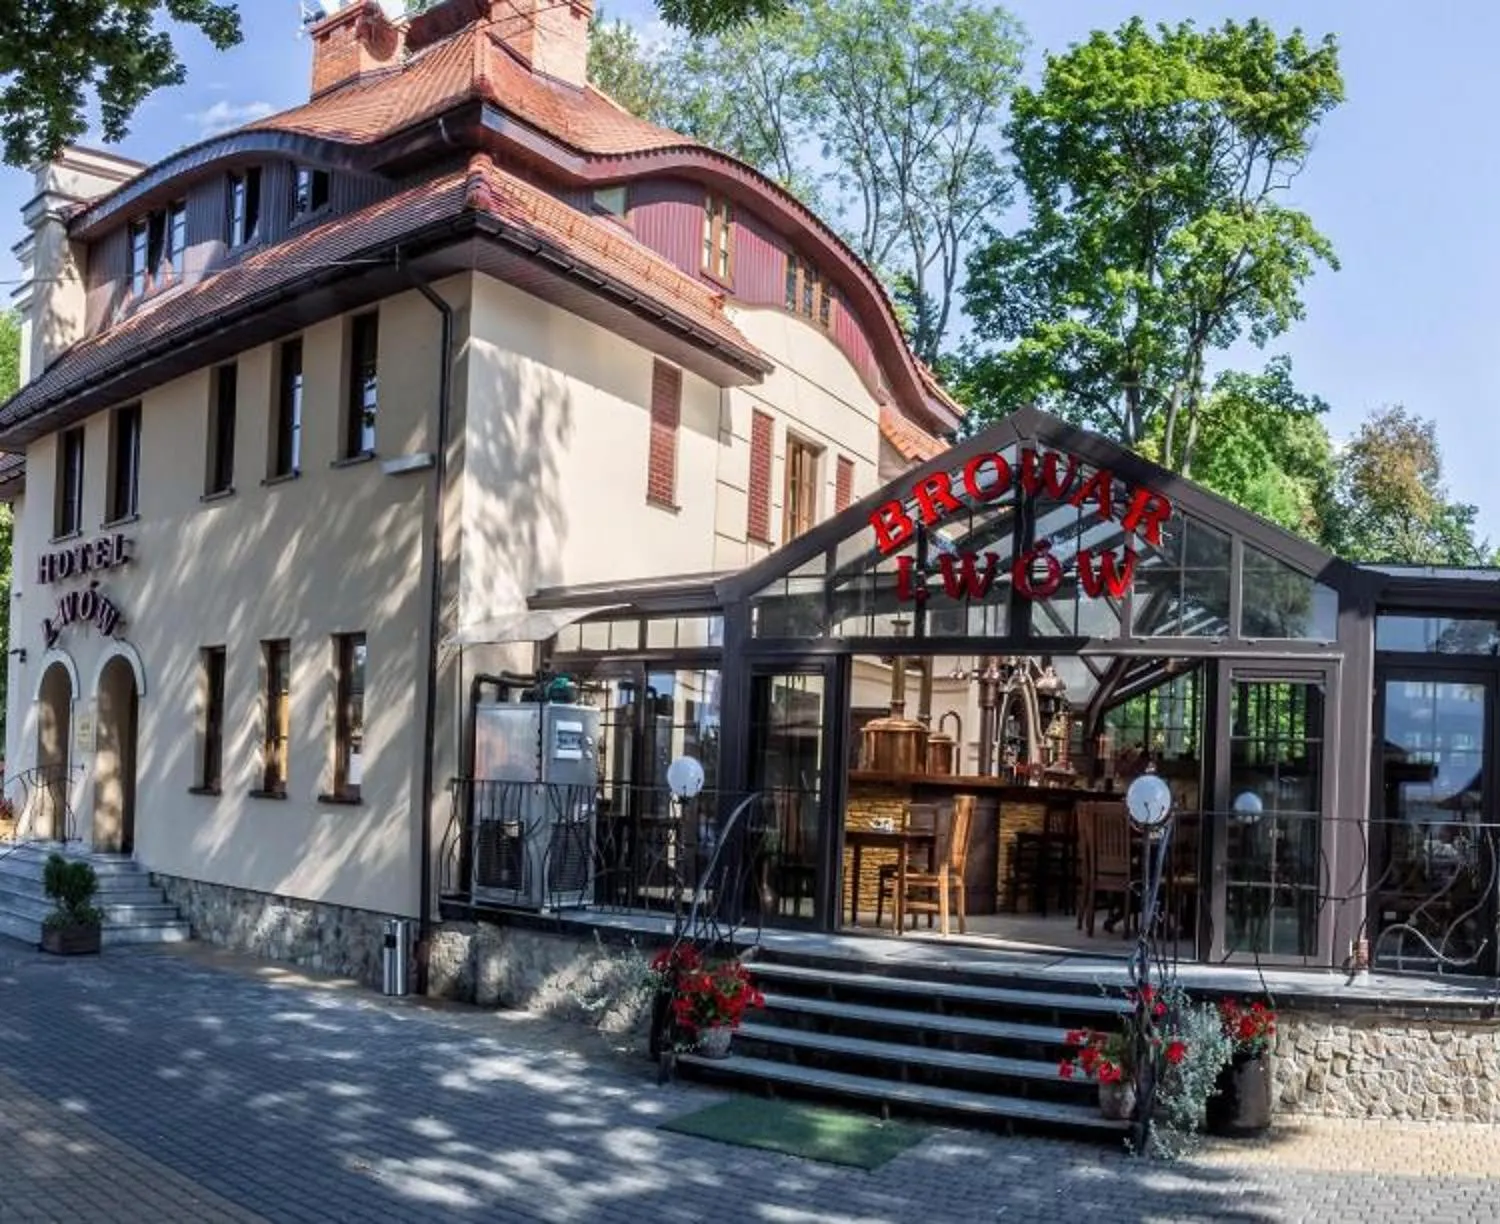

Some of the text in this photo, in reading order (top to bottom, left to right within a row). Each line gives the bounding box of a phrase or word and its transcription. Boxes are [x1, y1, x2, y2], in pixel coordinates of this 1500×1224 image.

[869, 449, 1173, 554] BROWAR
[37, 533, 128, 584] HOTEL
[895, 539, 1139, 602] LWÓW
[42, 580, 121, 649] LWÓW
